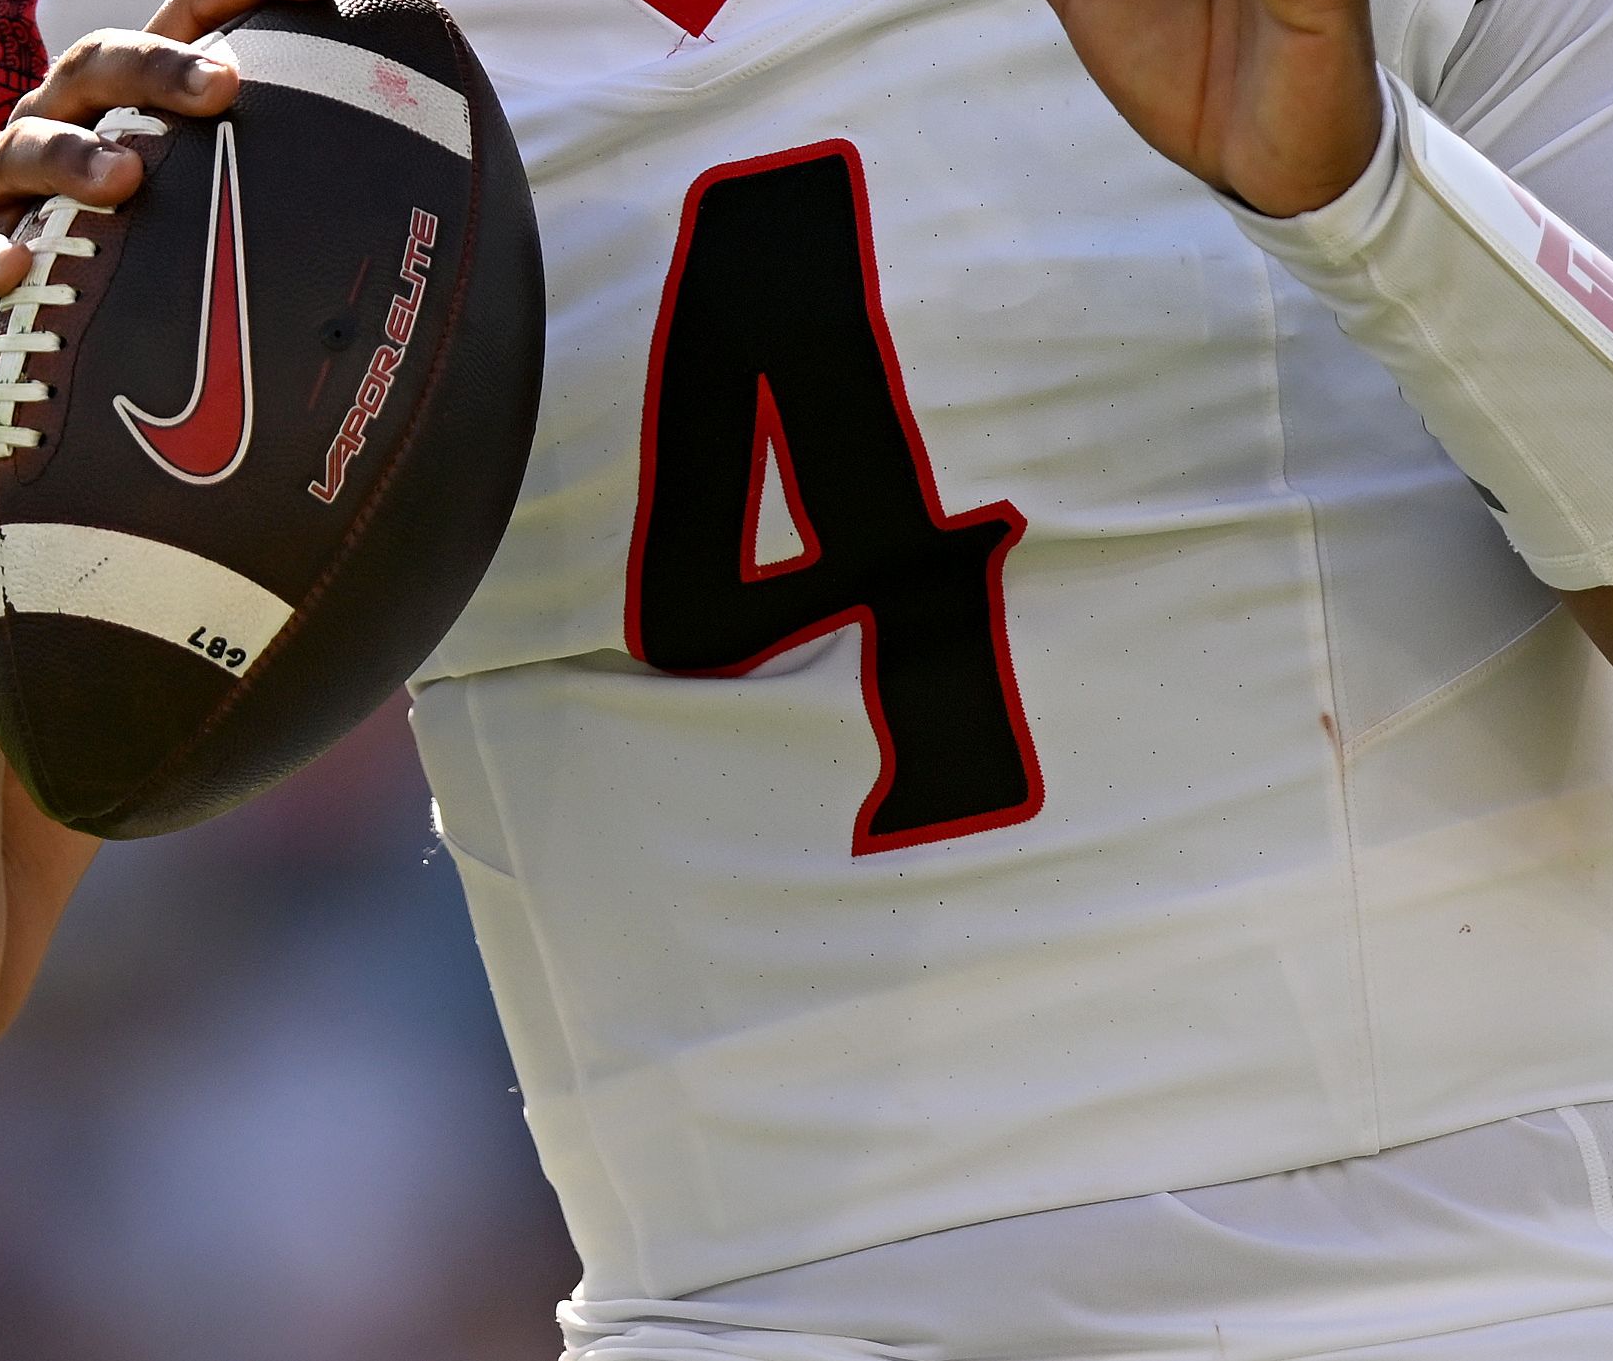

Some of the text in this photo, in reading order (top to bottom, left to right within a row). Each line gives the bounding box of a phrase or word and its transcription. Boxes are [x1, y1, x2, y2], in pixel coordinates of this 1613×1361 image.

[307, 206, 438, 504] VAPOR ELITE
[624, 138, 1045, 857] 4
